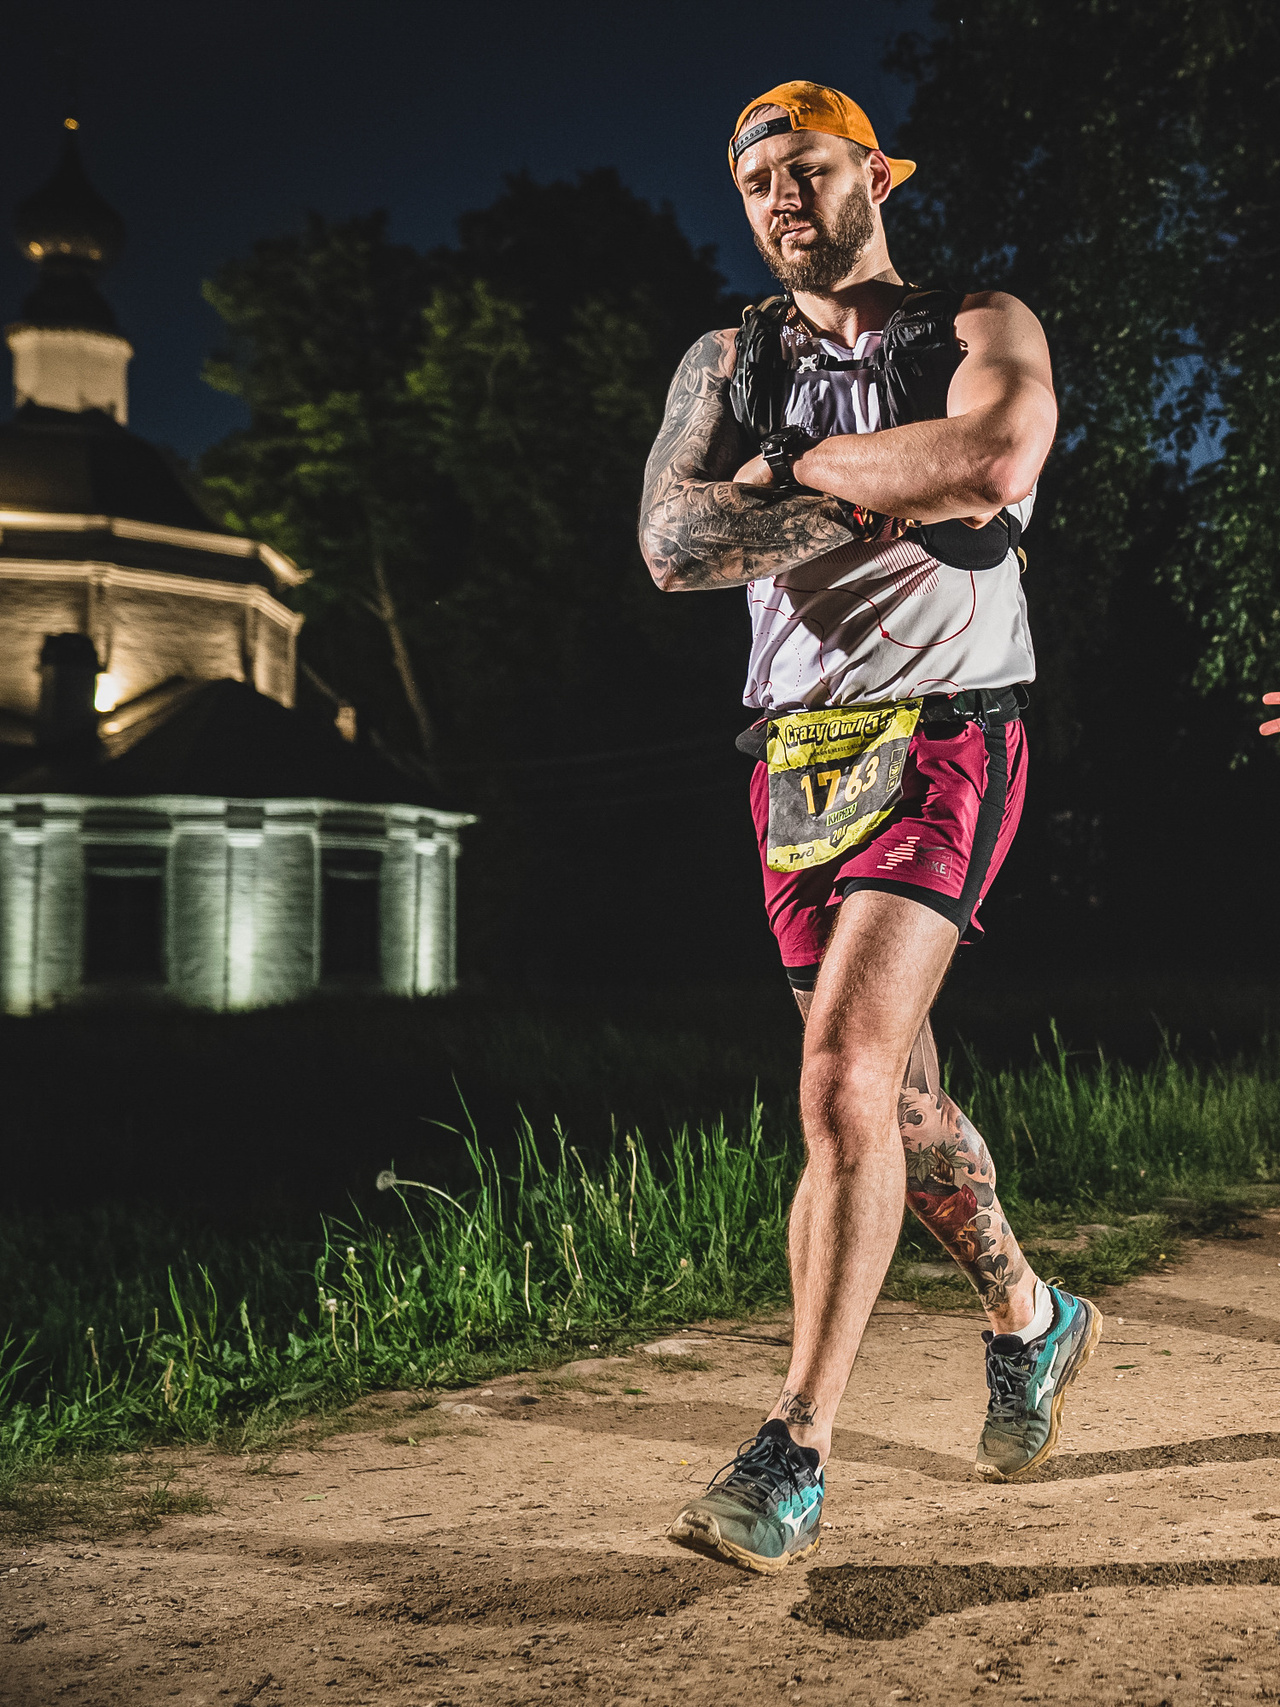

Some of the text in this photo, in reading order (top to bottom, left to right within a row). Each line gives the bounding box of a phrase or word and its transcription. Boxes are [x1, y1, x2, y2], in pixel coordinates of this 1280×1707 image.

[785, 723, 826, 748] Crazy
[827, 717, 863, 742] Owl
[801, 755, 880, 814] 1763
[828, 803, 856, 824] КИРЮХА
